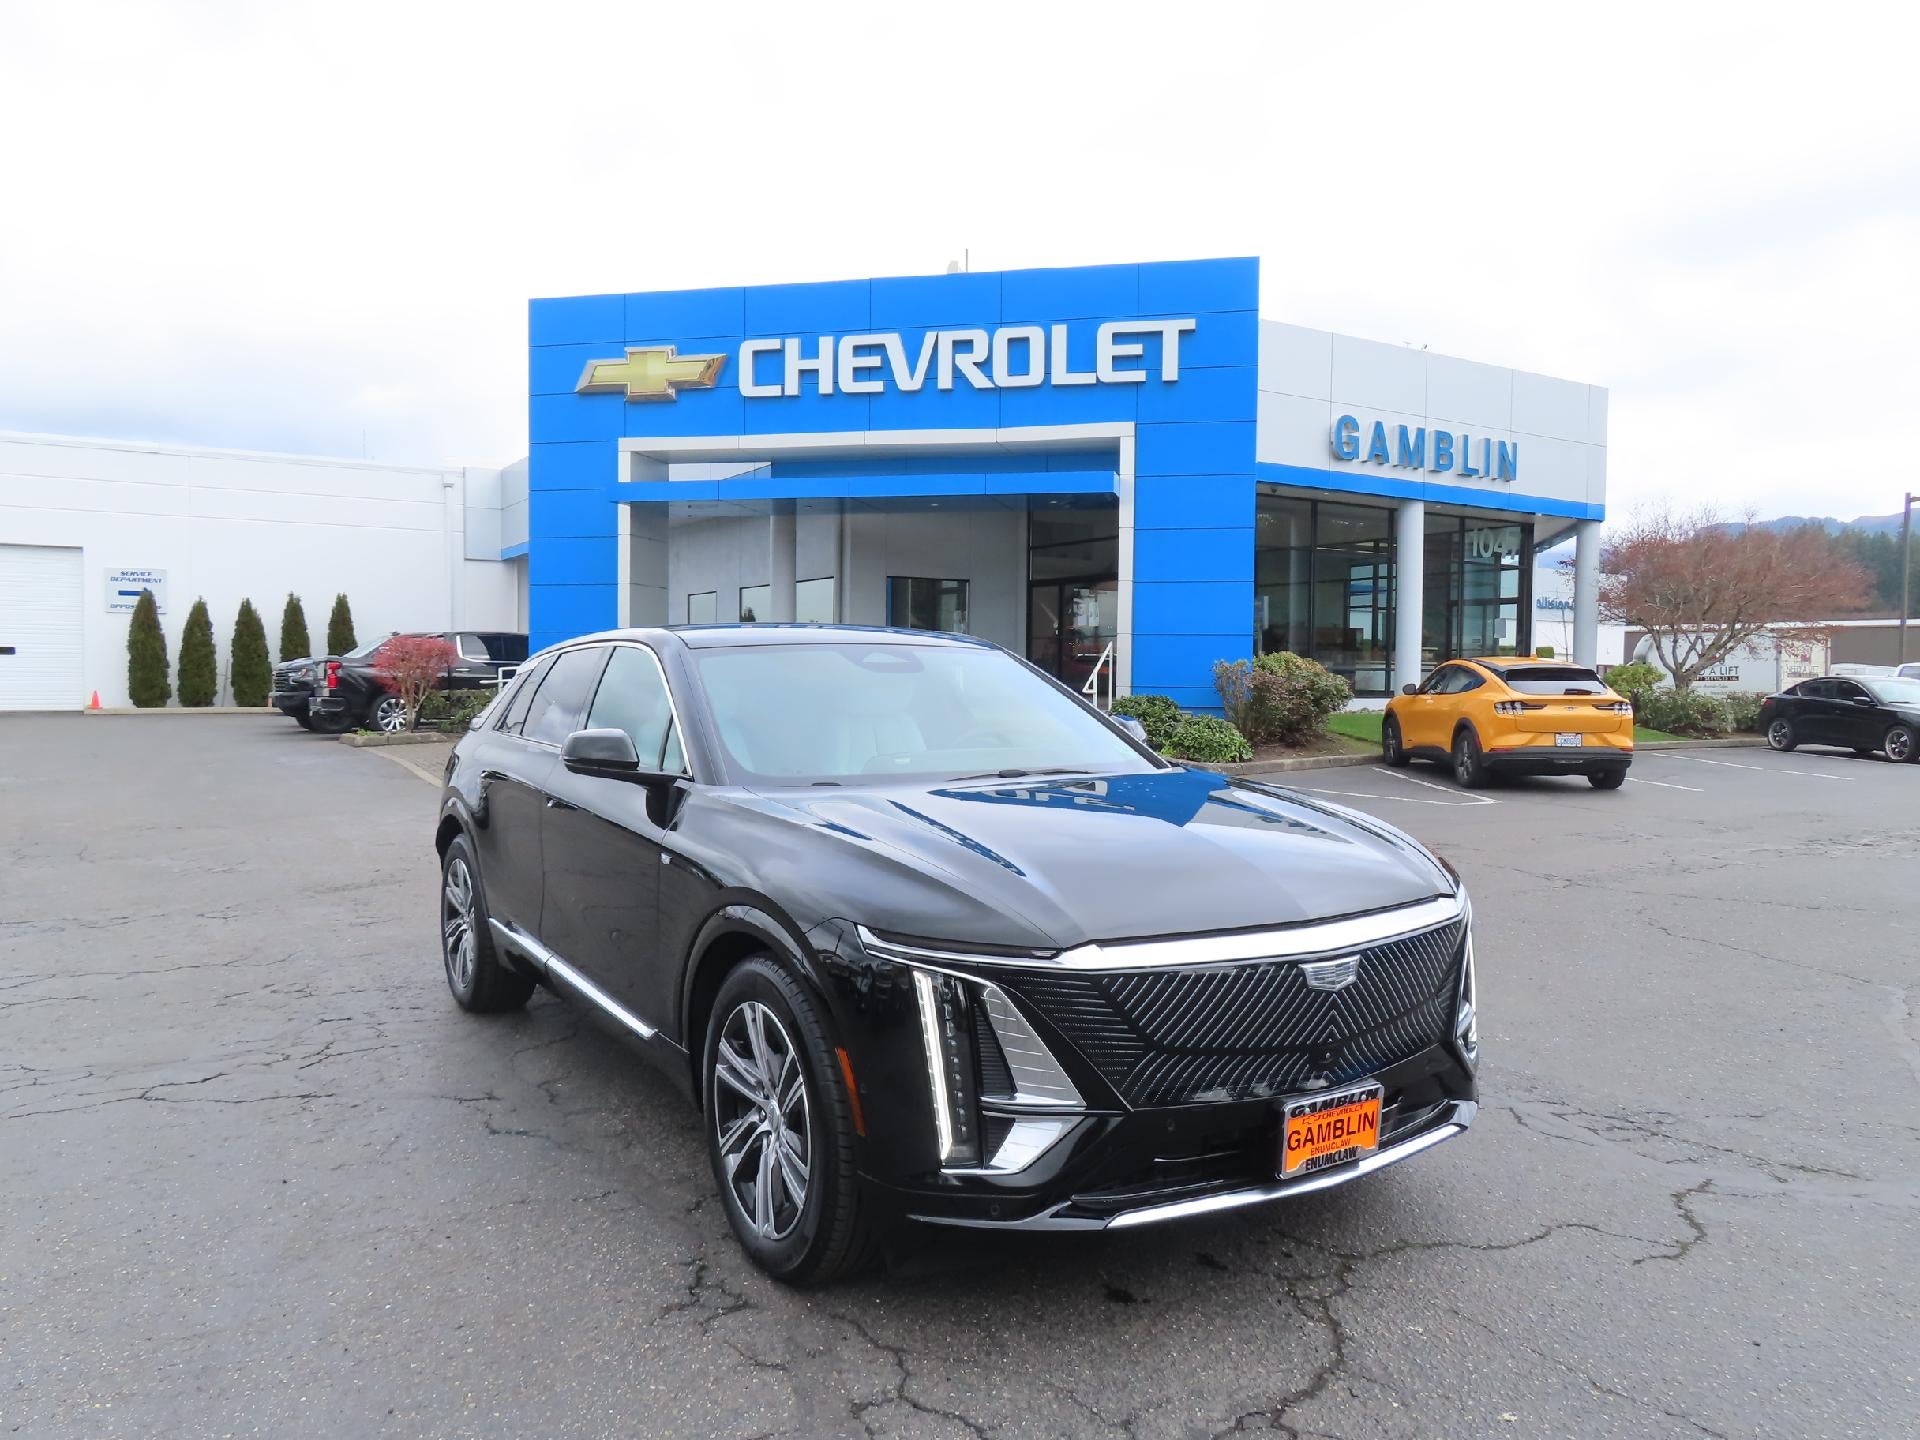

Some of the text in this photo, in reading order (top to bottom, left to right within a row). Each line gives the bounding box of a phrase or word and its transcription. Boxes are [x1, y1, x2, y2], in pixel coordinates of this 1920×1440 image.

[739, 319, 1196, 399] CHEVROLET
[1333, 415, 1517, 482] GAMBLIN
[1719, 666, 1739, 675] LIFT
[1290, 1086, 1379, 1118] GAMBLIN
[1322, 1104, 1363, 1119] CHEVROLET
[1287, 1111, 1375, 1151] GAMBLIN
[1306, 1146, 1358, 1171] ENUMCLAW
[1310, 1138, 1351, 1156] ENUMCLAW
